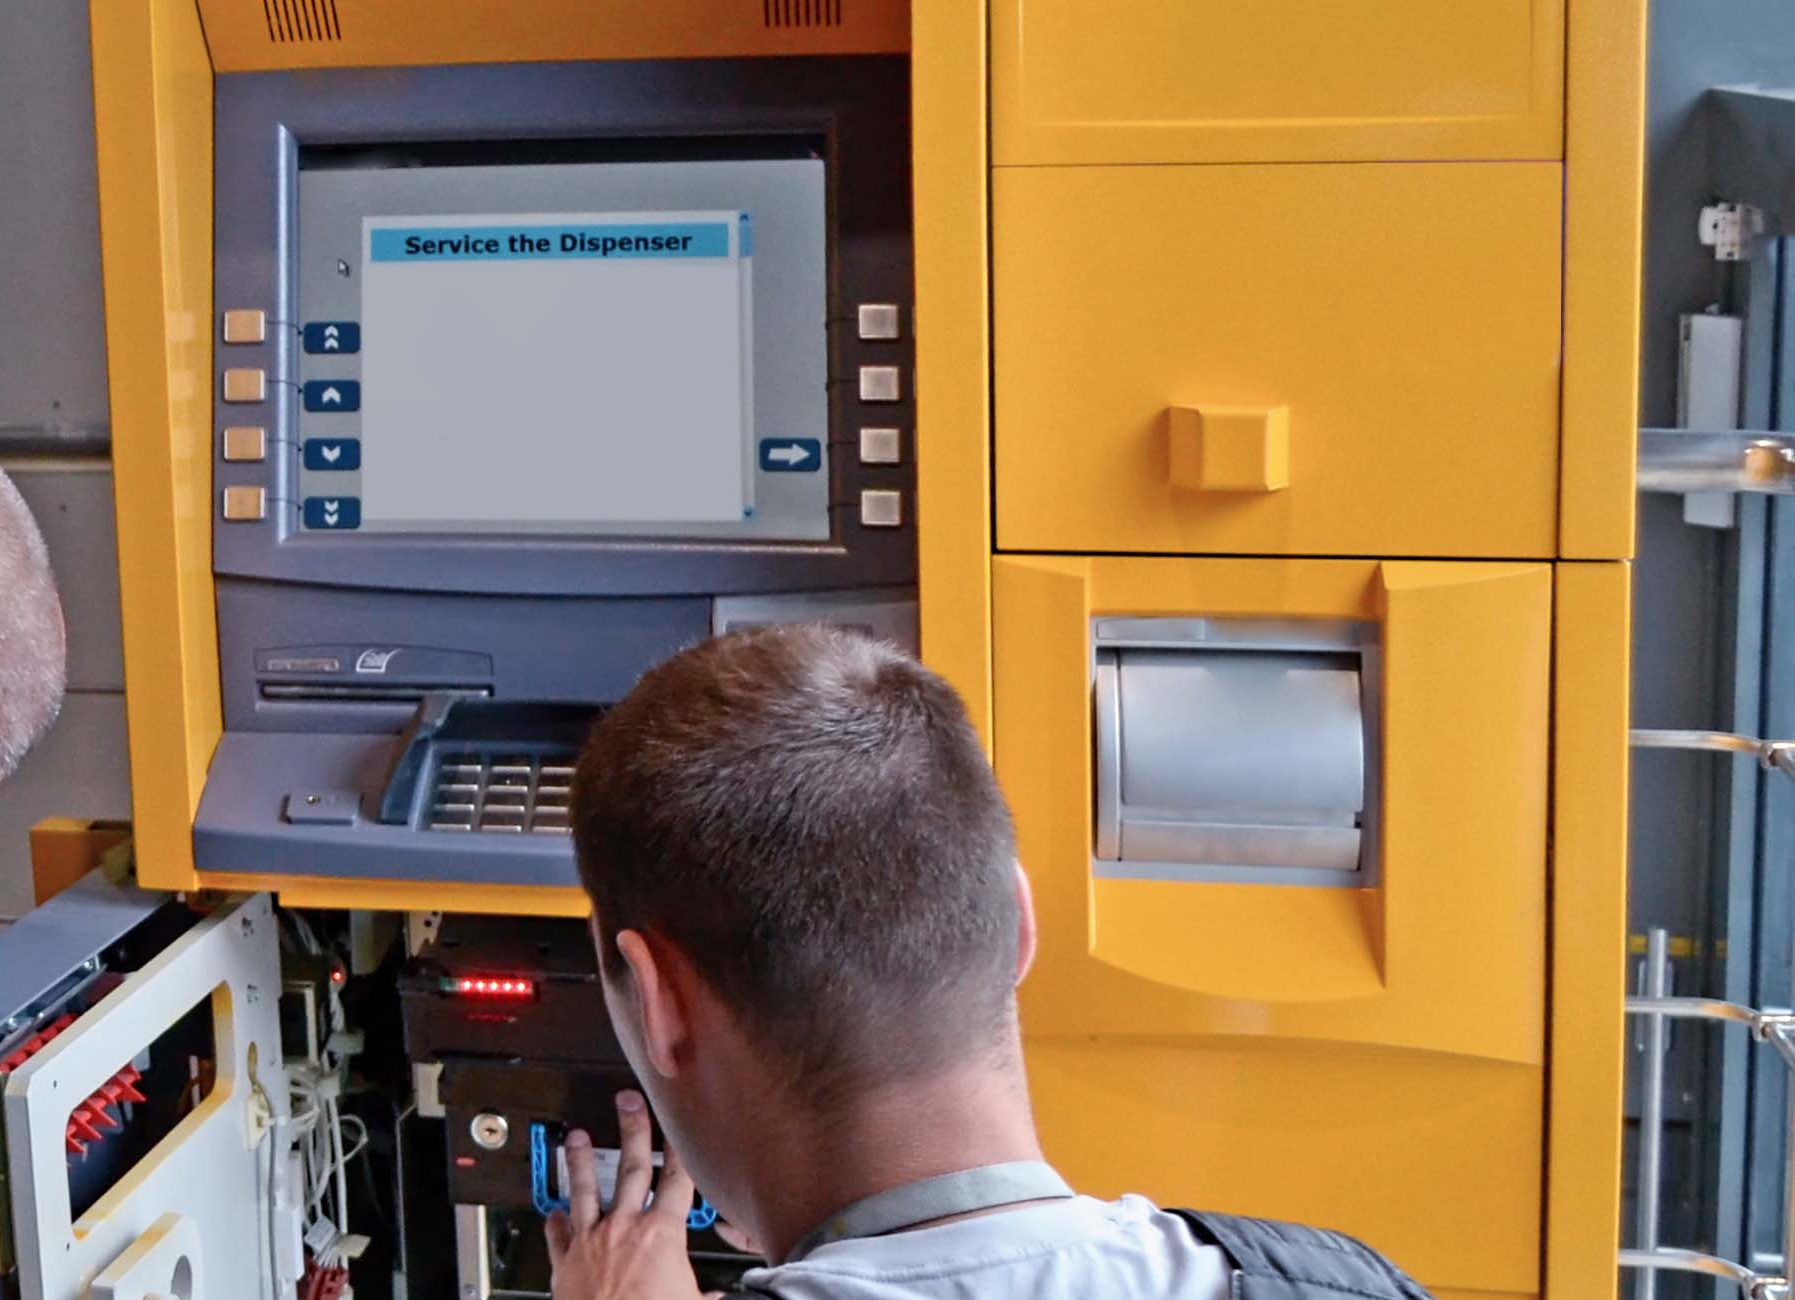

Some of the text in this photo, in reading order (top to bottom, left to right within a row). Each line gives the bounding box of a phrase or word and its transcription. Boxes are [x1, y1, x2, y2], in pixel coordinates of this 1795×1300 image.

[405, 232, 693, 257] Service the Dispenser
